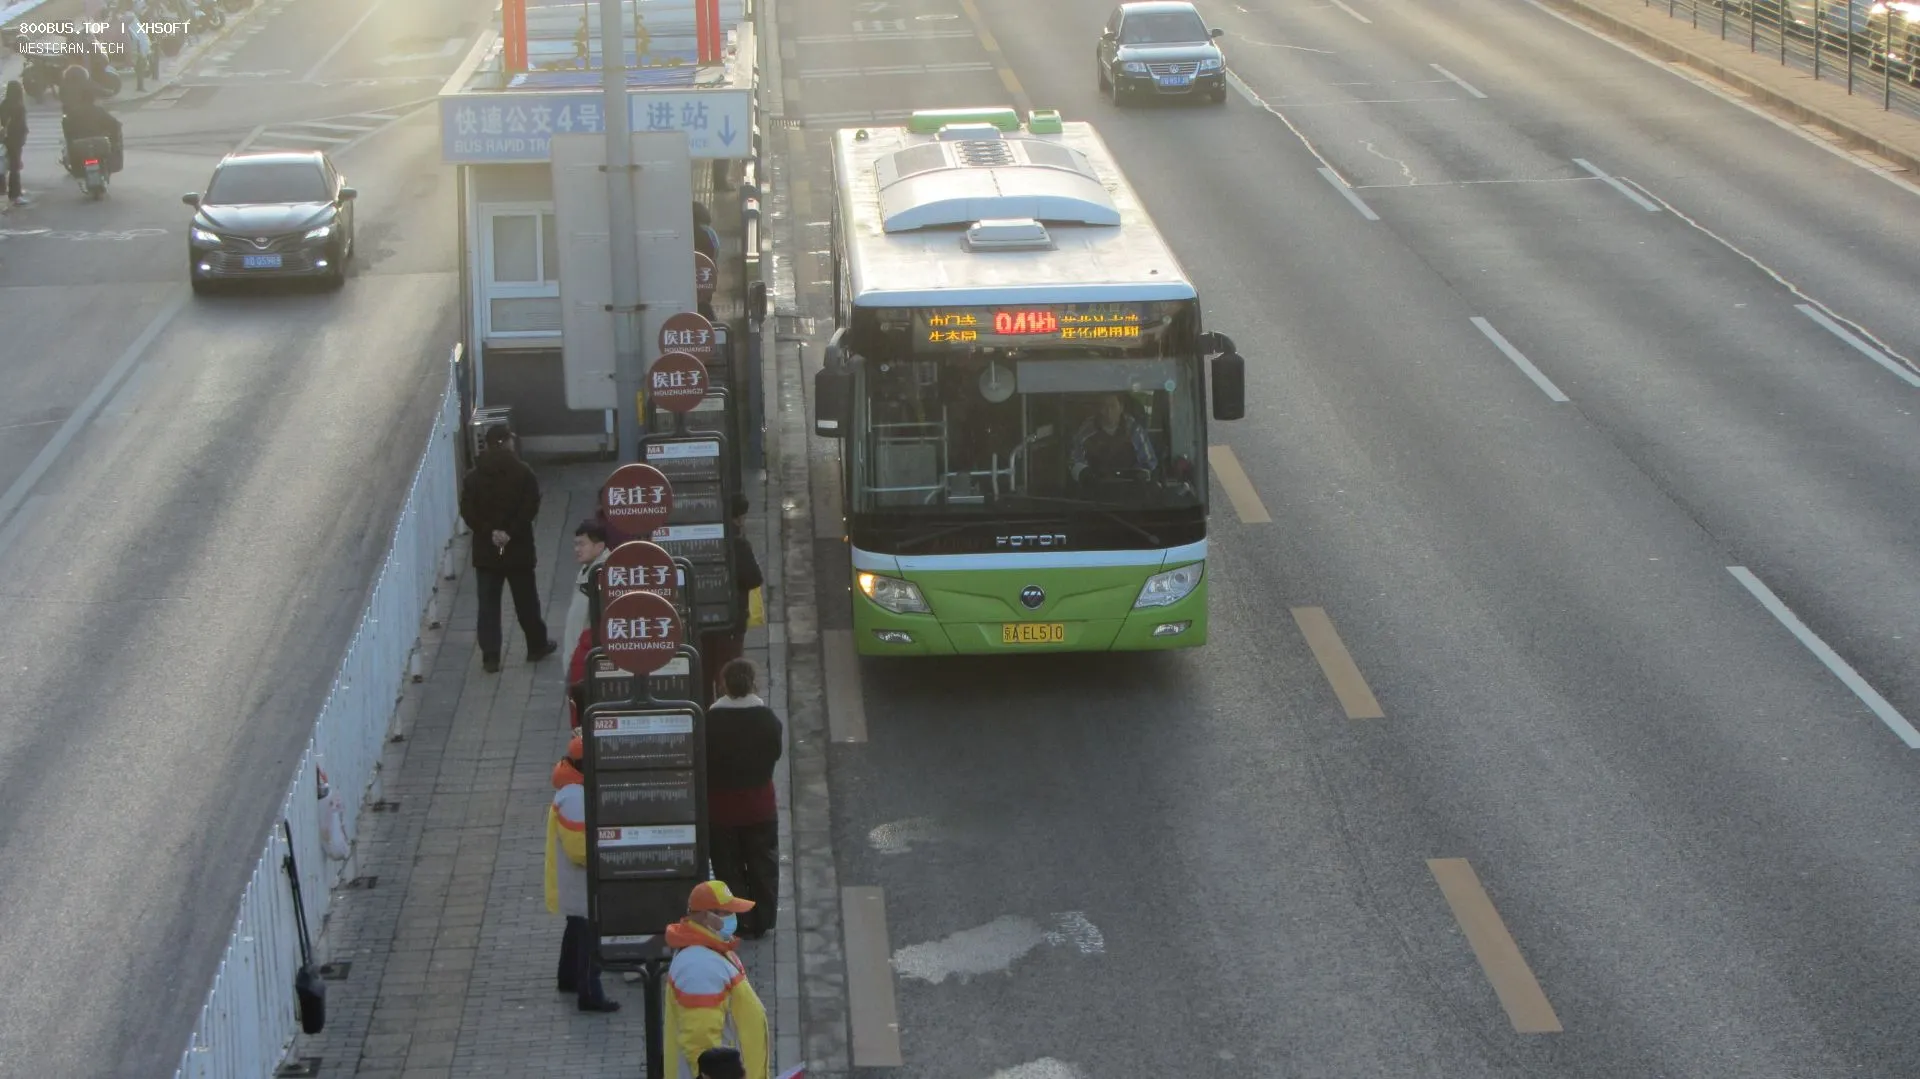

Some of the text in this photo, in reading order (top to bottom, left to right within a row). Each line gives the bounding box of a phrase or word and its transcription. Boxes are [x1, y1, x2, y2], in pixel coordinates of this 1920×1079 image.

[647, 101, 709, 130] 进站
[454, 140, 482, 153] BUS
[486, 139, 525, 153] RAPID
[664, 329, 710, 345] 侯庄子
[653, 370, 702, 388] 侯庄子
[654, 388, 703, 396] HOUZHUANGZI
[608, 486, 667, 506] 侯庄子
[609, 506, 667, 516] HOUZHUANGZI
[608, 565, 672, 587] 侯庄子
[607, 617, 675, 640] 侯庄子
[608, 641, 675, 651] HOUZHUANGZI
[595, 720, 614, 730] M22
[599, 830, 615, 839] M20
